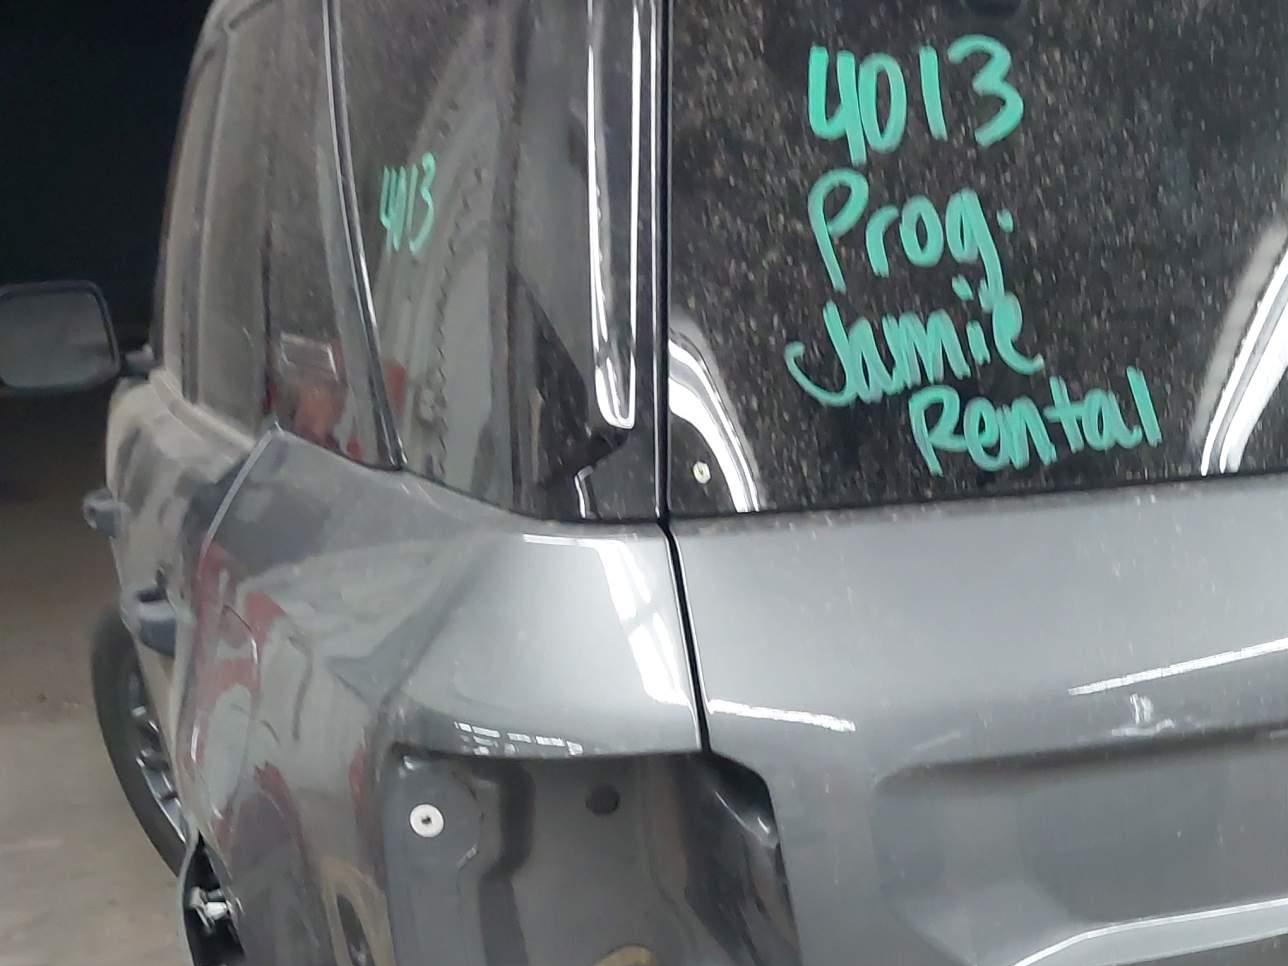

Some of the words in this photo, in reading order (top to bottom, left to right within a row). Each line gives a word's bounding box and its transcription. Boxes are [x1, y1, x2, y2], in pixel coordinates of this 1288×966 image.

[807, 34, 1025, 167] 4013
[807, 167, 1014, 312] Prog.
[784, 275, 1045, 406] Jamie
[908, 366, 1163, 477] Rental
